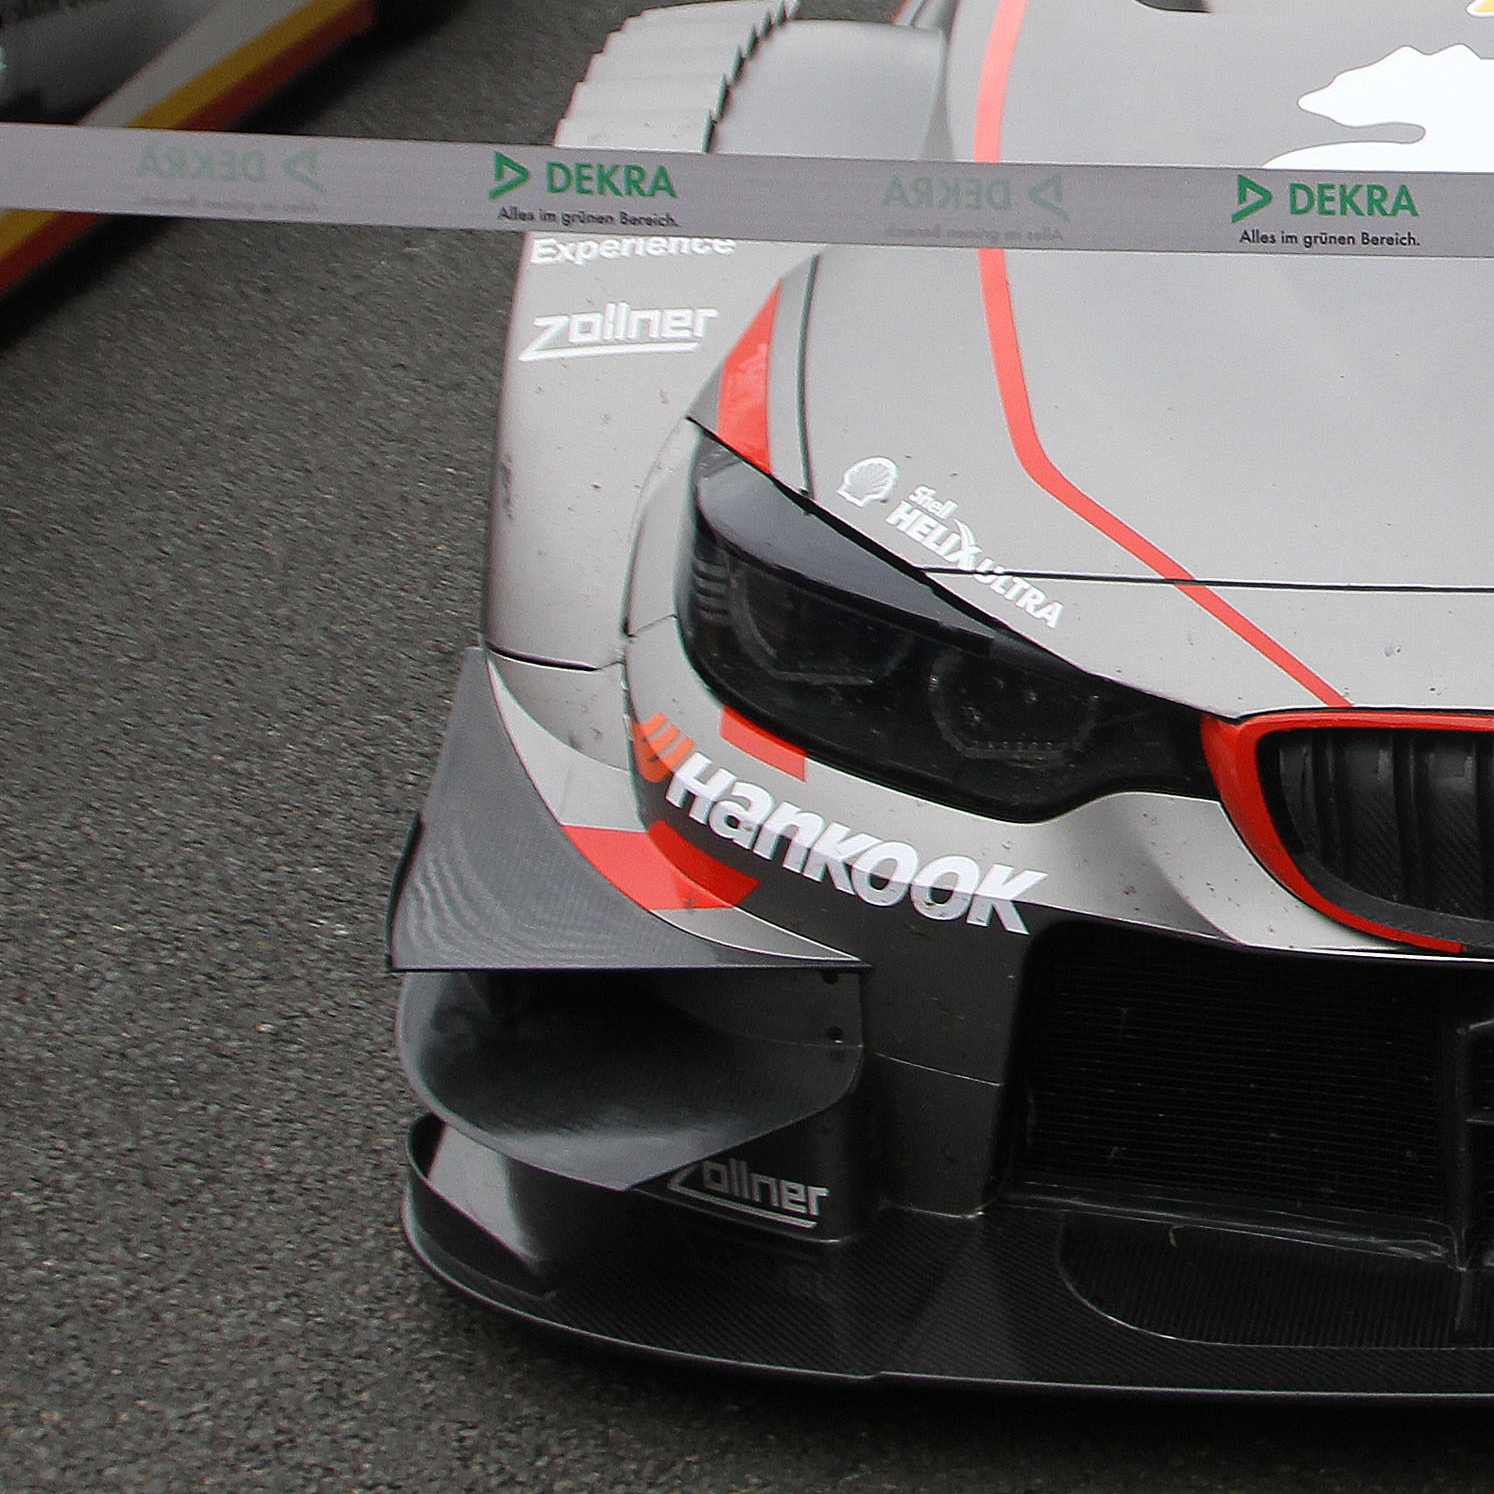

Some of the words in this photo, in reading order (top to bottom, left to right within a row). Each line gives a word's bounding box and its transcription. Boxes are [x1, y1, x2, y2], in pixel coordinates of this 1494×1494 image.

[547, 162, 677, 199] DEKRA
[1289, 183, 1419, 217] DEKRA
[530, 236, 738, 266] Experience
[1239, 228, 1276, 244] Alles
[1281, 231, 1298, 244] im
[1303, 231, 1356, 248] grünen
[1361, 231, 1420, 246] Bereich.
[909, 483, 960, 521] Shell
[885, 500, 984, 571] HELIX
[973, 556, 1065, 630] ULTRA
